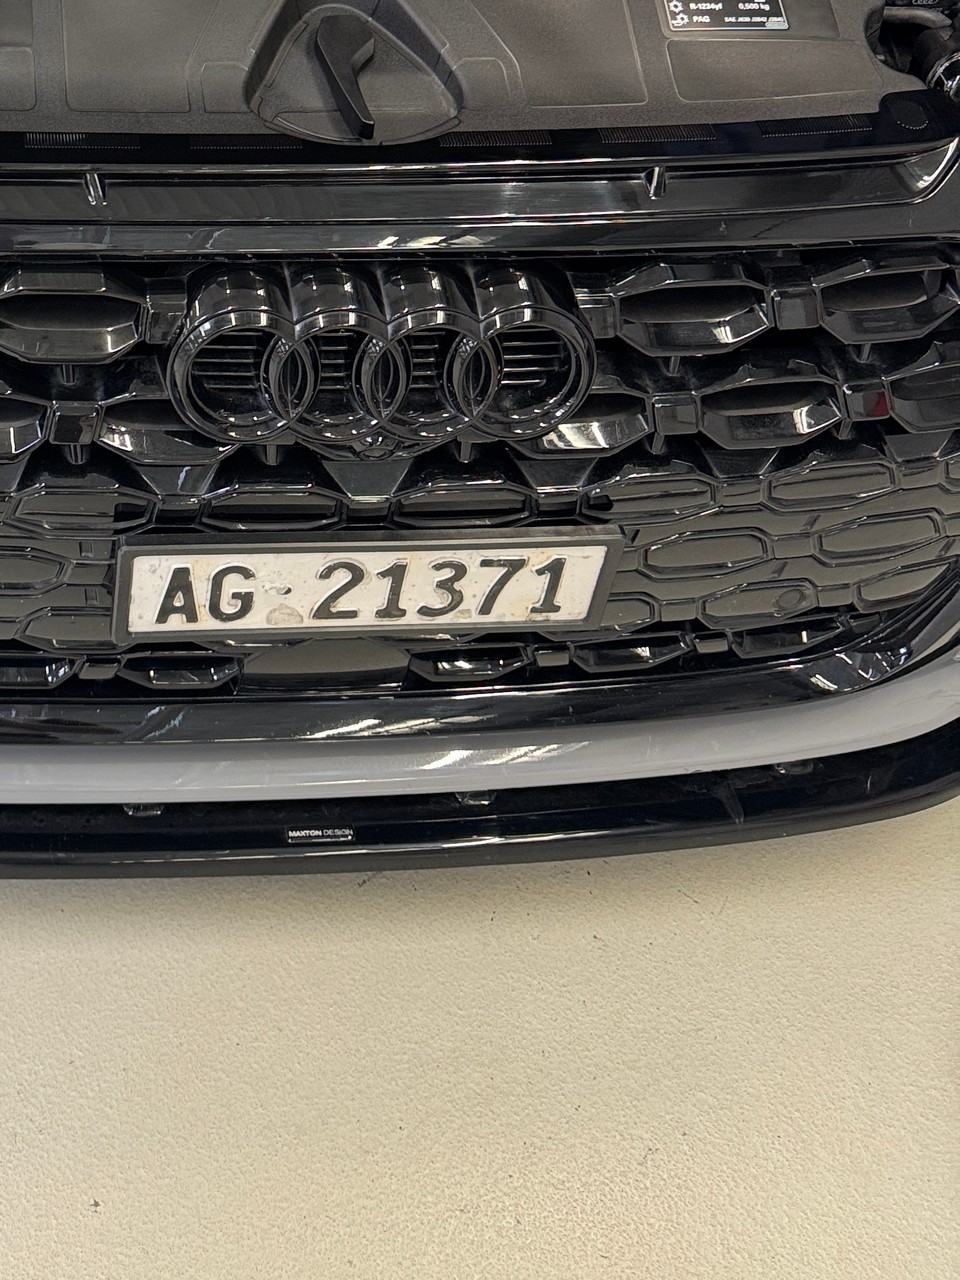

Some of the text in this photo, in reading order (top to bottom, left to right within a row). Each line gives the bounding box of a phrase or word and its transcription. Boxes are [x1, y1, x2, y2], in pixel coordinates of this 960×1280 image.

[689, 2, 771, 11] R-1234yf 0,500 kg
[154, 557, 567, 625] AG 21371
[323, 828, 353, 836] DESIGN
